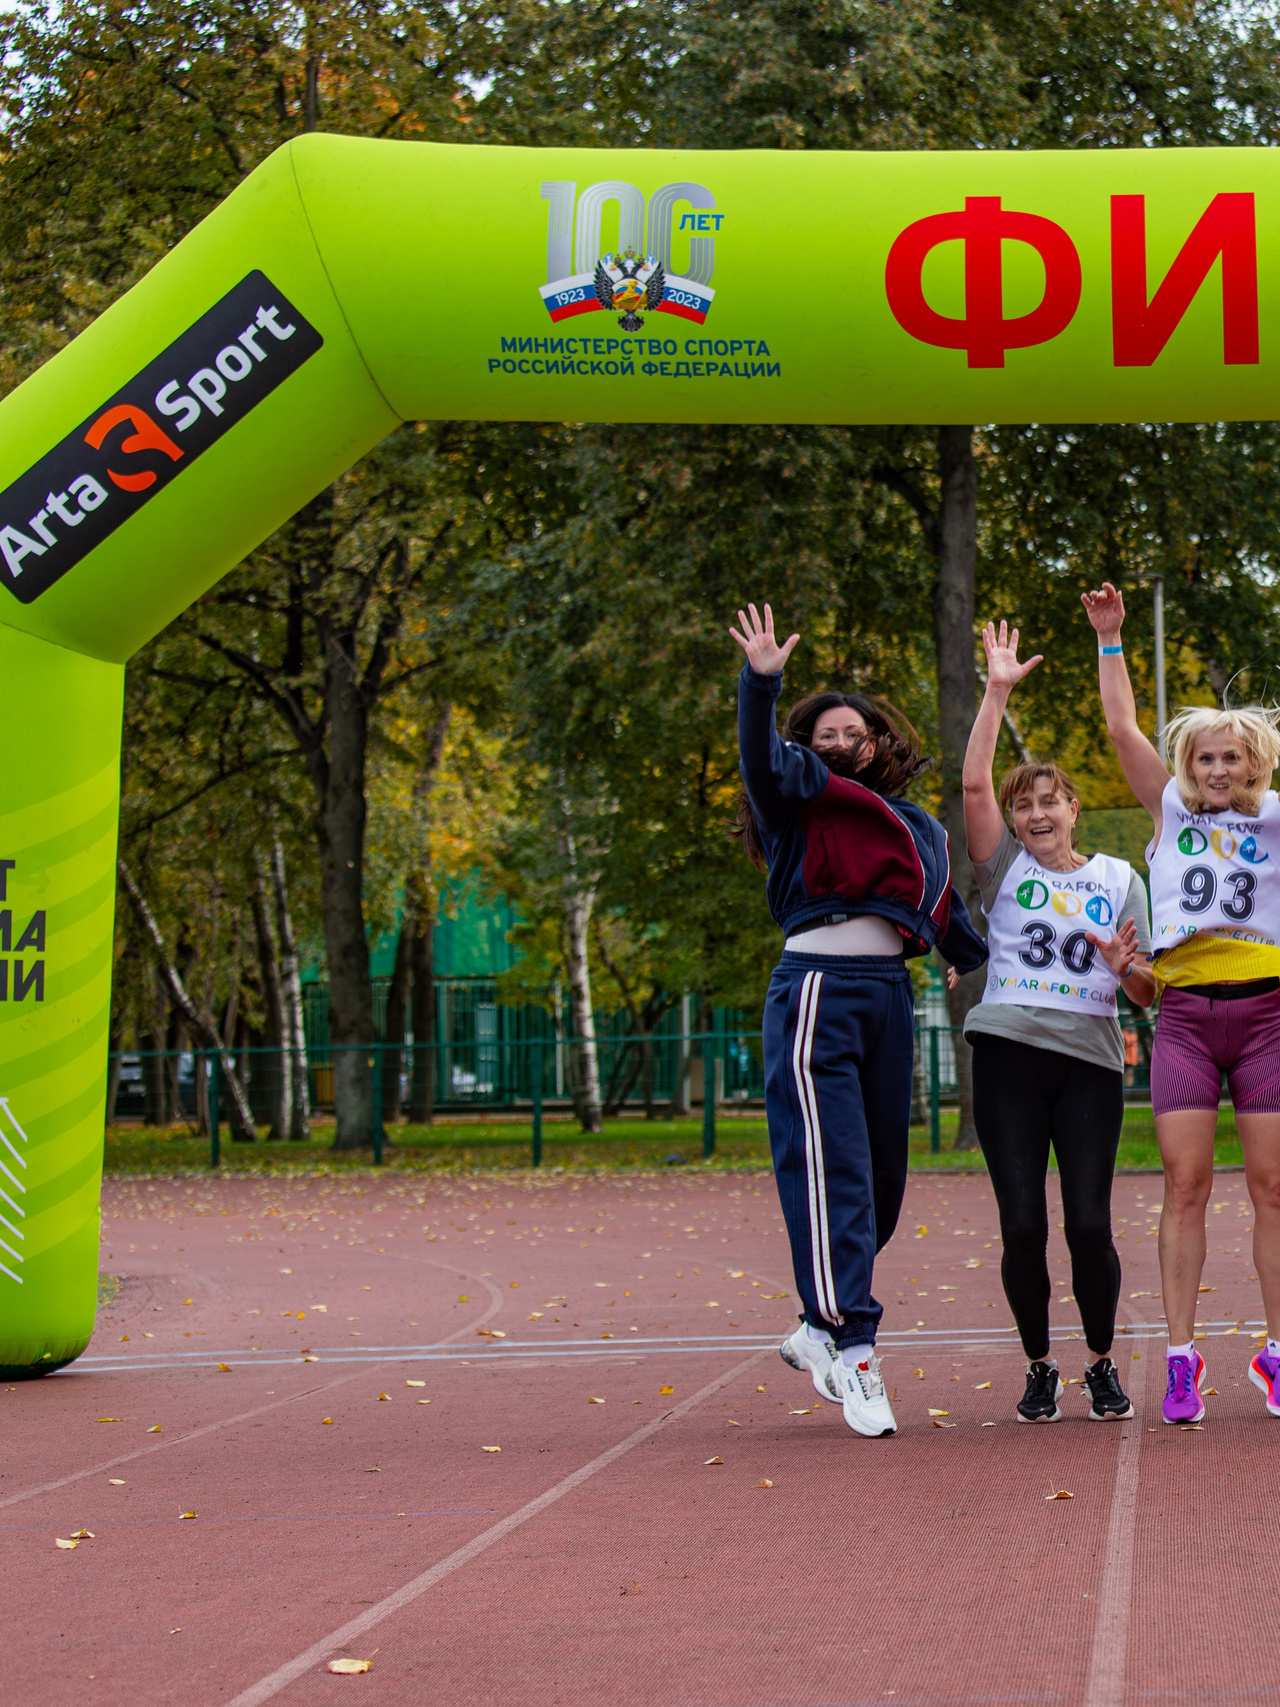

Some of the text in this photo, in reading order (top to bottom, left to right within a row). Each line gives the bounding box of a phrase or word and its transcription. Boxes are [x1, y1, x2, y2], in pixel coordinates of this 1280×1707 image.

[678, 213, 726, 232] ЛЕТ
[554, 288, 586, 307] 1923
[666, 288, 702, 310] 2023
[500, 336, 771, 357] МИНИСТЕРСТВО СПОРТА
[488, 355, 781, 379] РОССИЙСКОЙ ФЕДЕРАЦИИ
[0, 304, 297, 578] Arta Sport
[1178, 863, 1258, 923] 93
[1018, 919, 1098, 977] 30
[999, 977, 1116, 1005] VMARAFONE.CLUB
